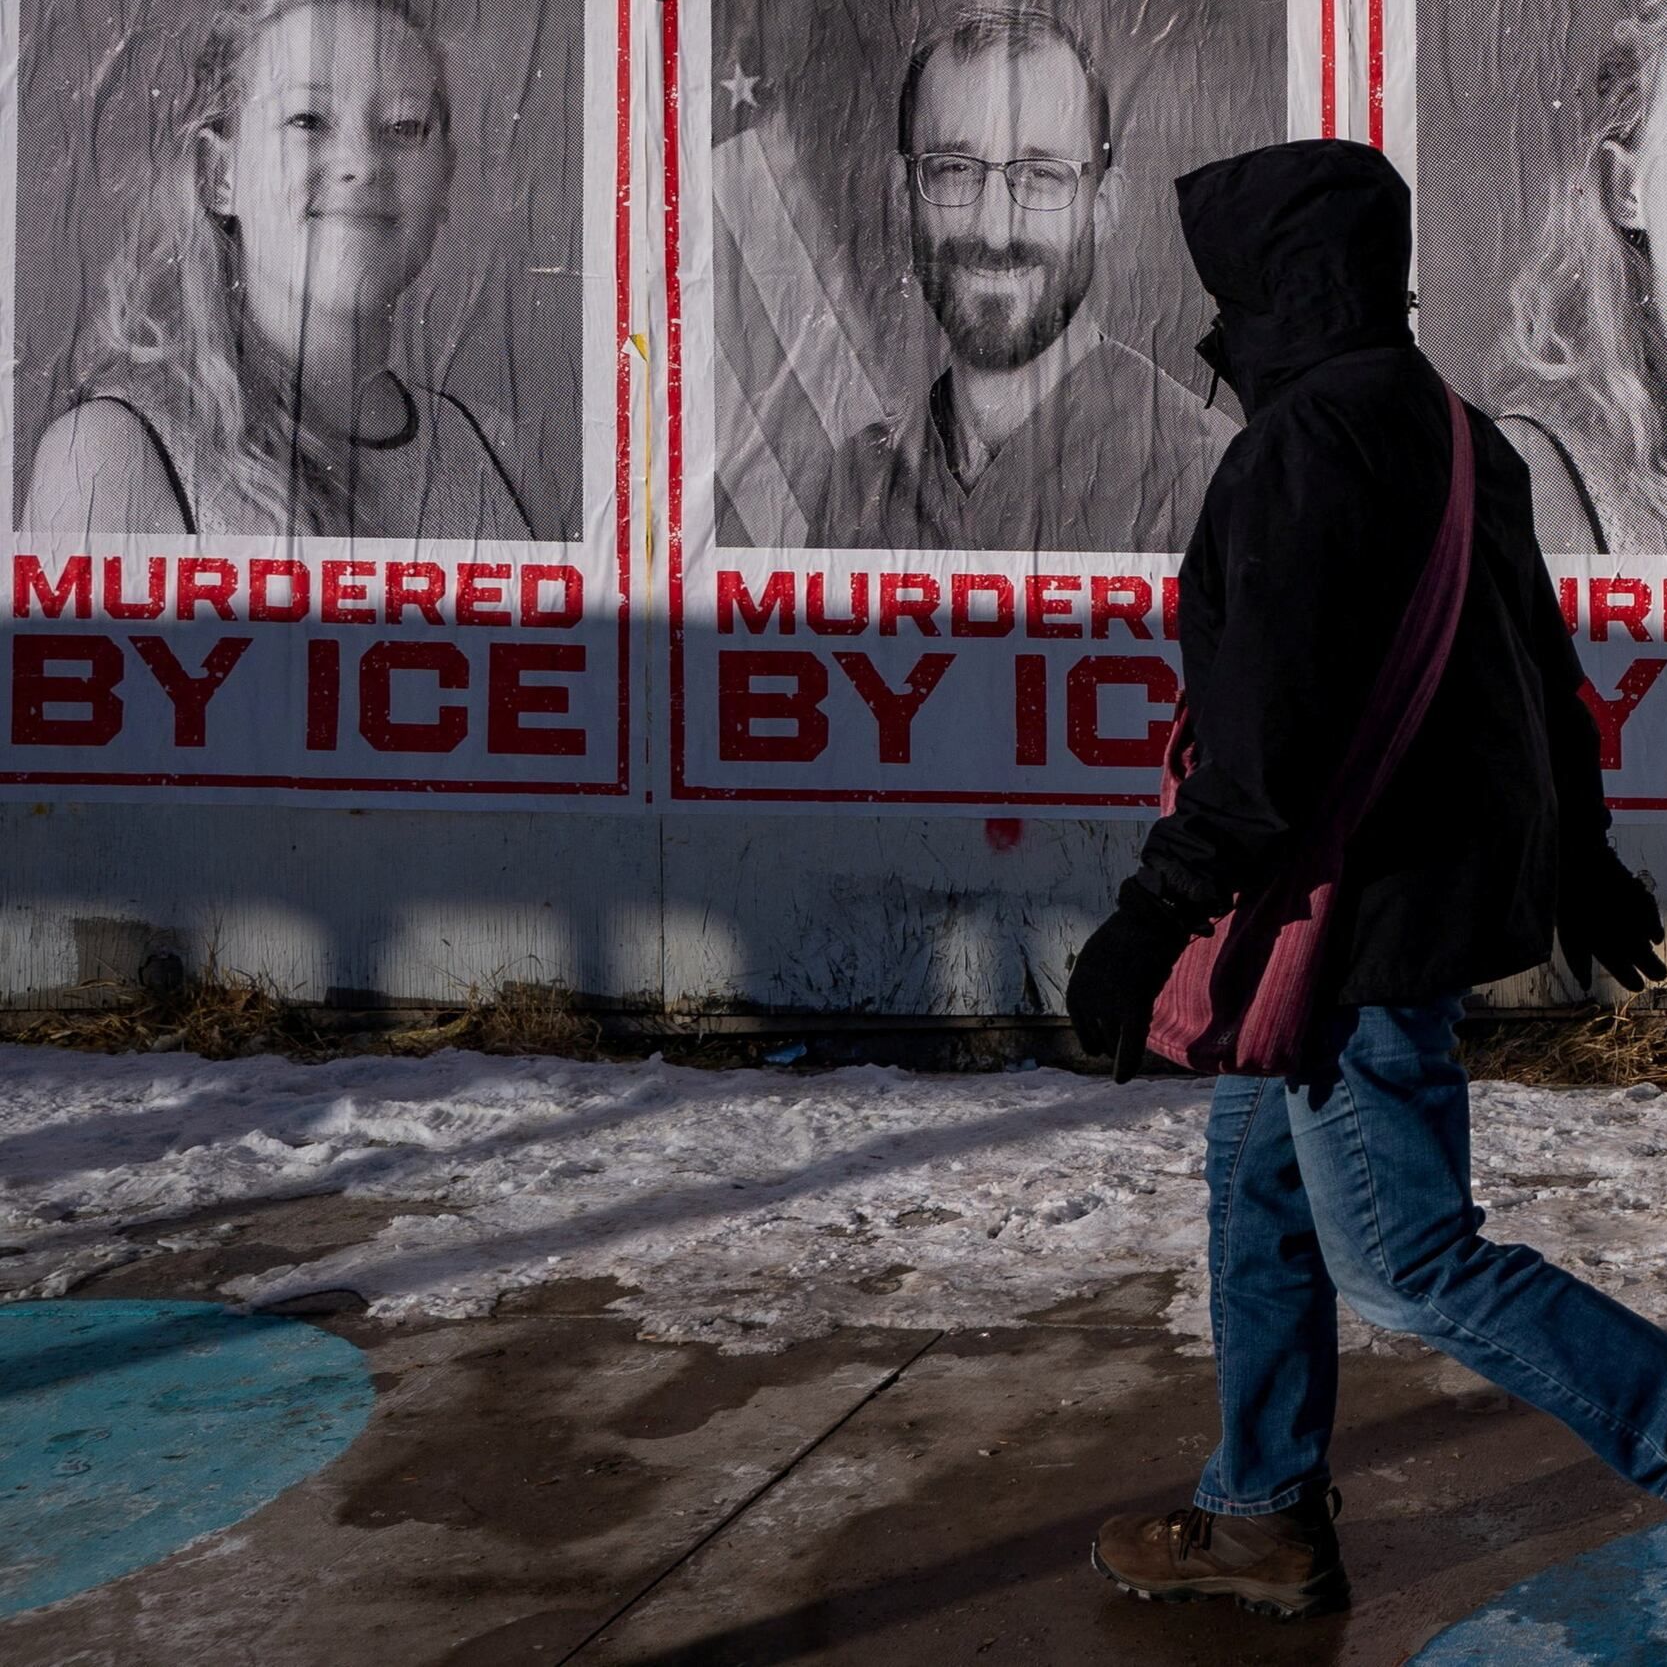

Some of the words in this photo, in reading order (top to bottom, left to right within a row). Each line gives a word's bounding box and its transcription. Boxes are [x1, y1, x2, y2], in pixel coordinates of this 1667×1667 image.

[12, 554, 584, 628] MURDERED
[716, 570, 1182, 641] MURDER
[12, 635, 253, 747] BY
[306, 638, 587, 755] ICE
[718, 650, 957, 764] BY
[1015, 653, 1179, 767] IC
